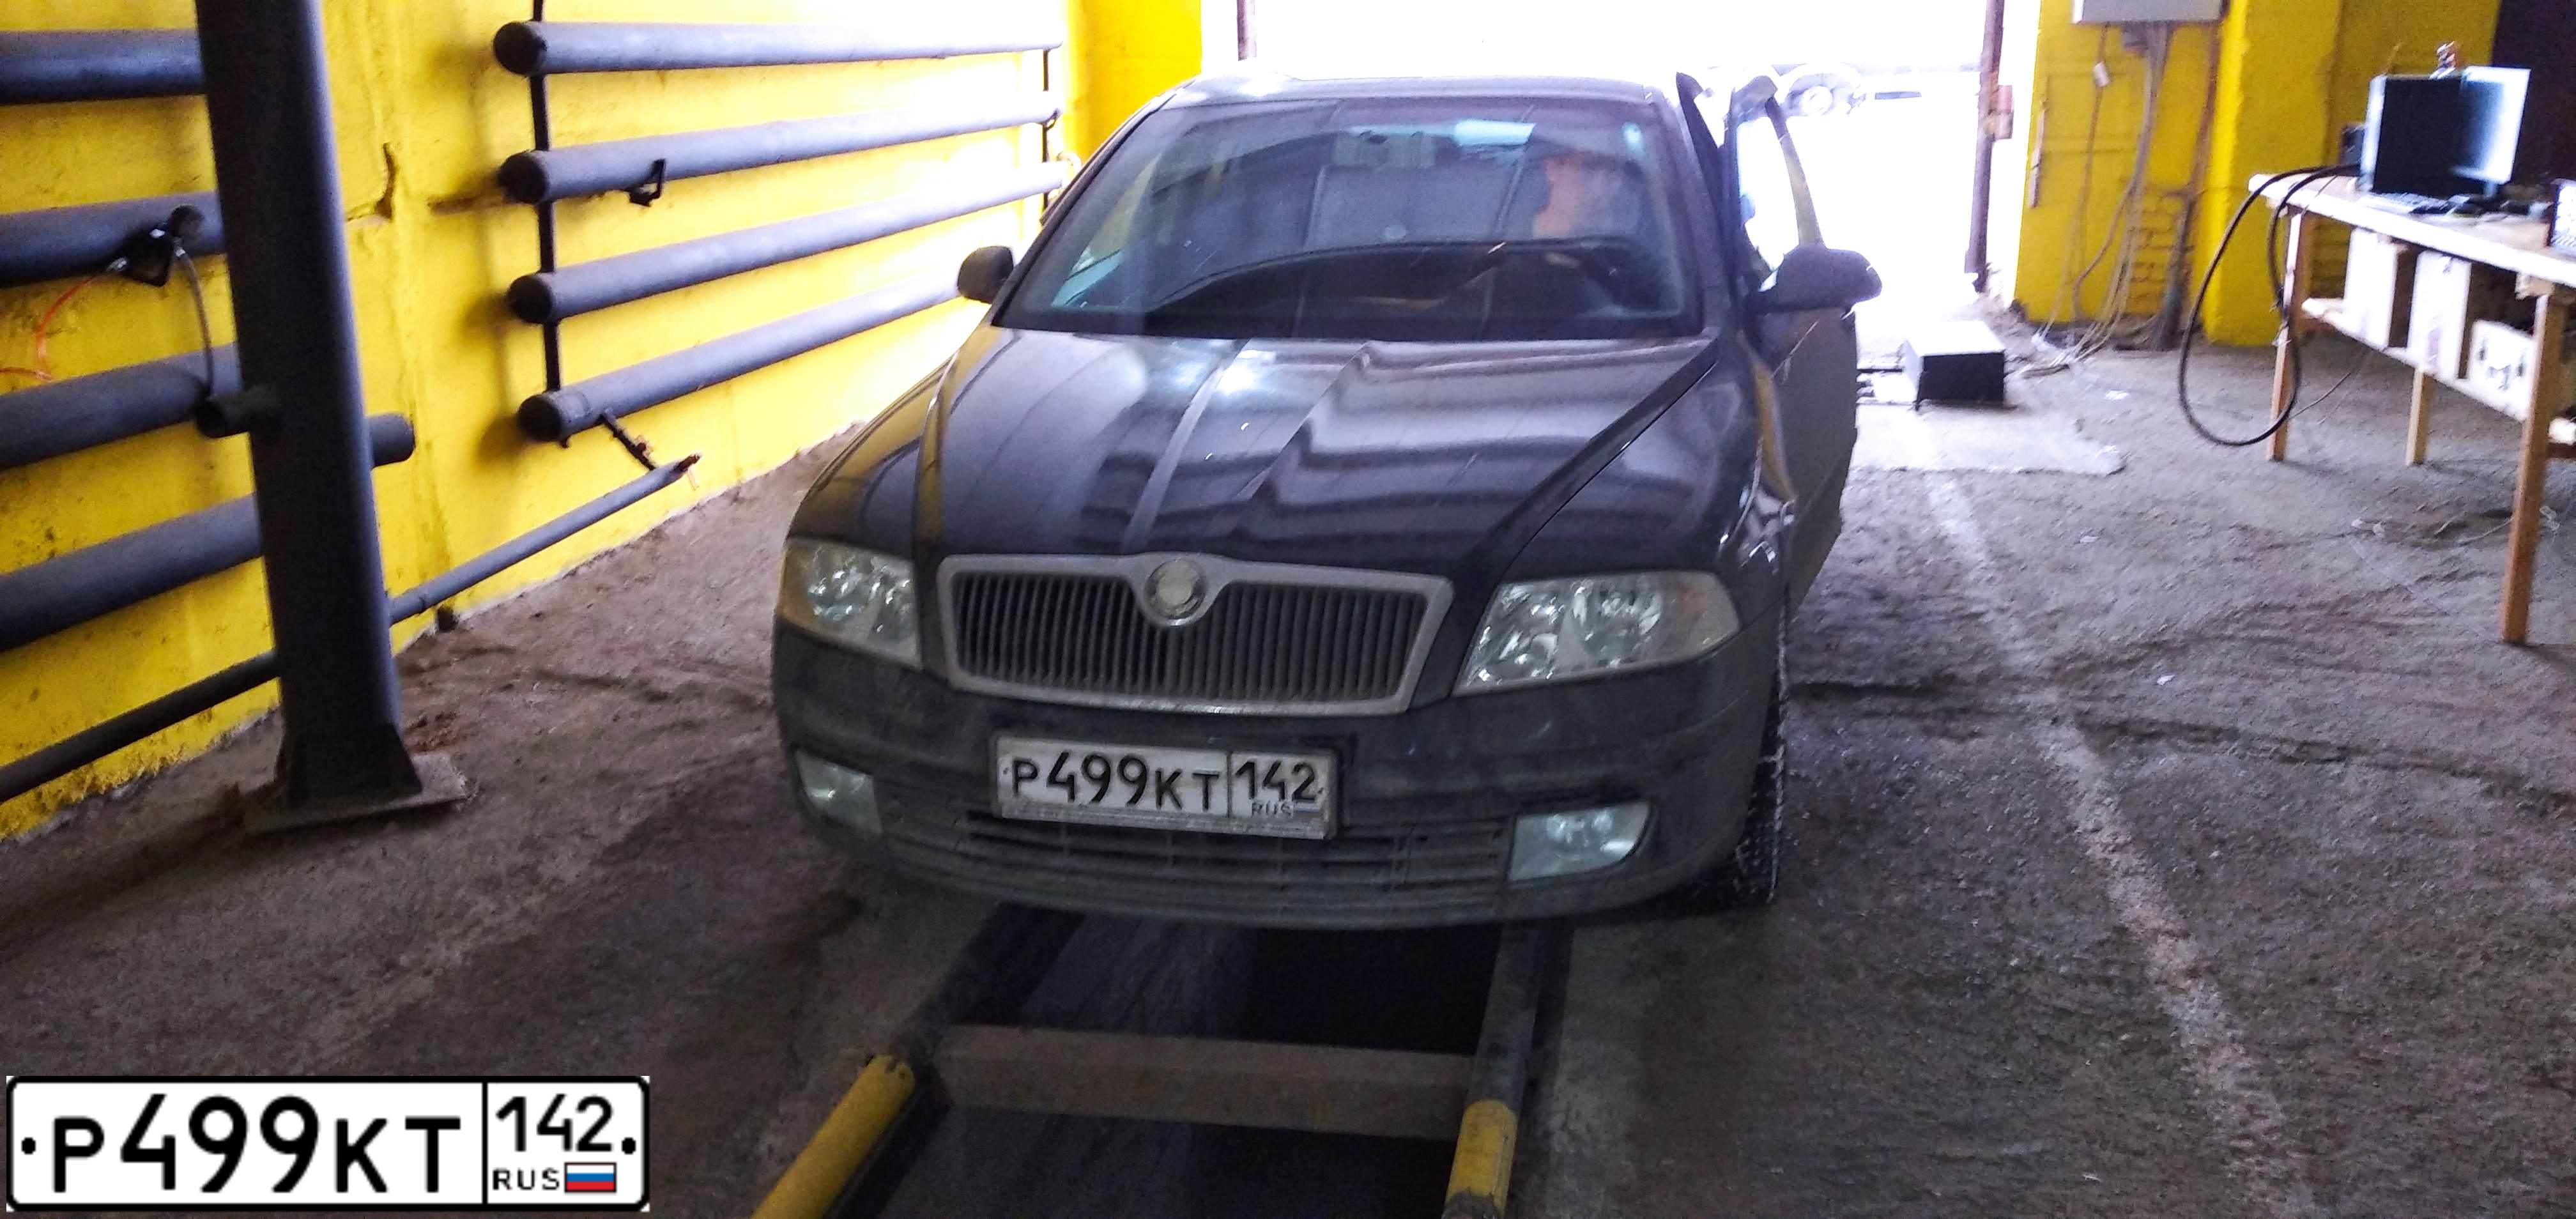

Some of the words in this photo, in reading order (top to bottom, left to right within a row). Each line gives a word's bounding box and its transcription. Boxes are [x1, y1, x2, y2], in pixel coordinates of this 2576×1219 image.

[1012, 750, 1219, 811] P499KT
[1235, 760, 1316, 802] 142
[1251, 801, 1292, 817] RUS
